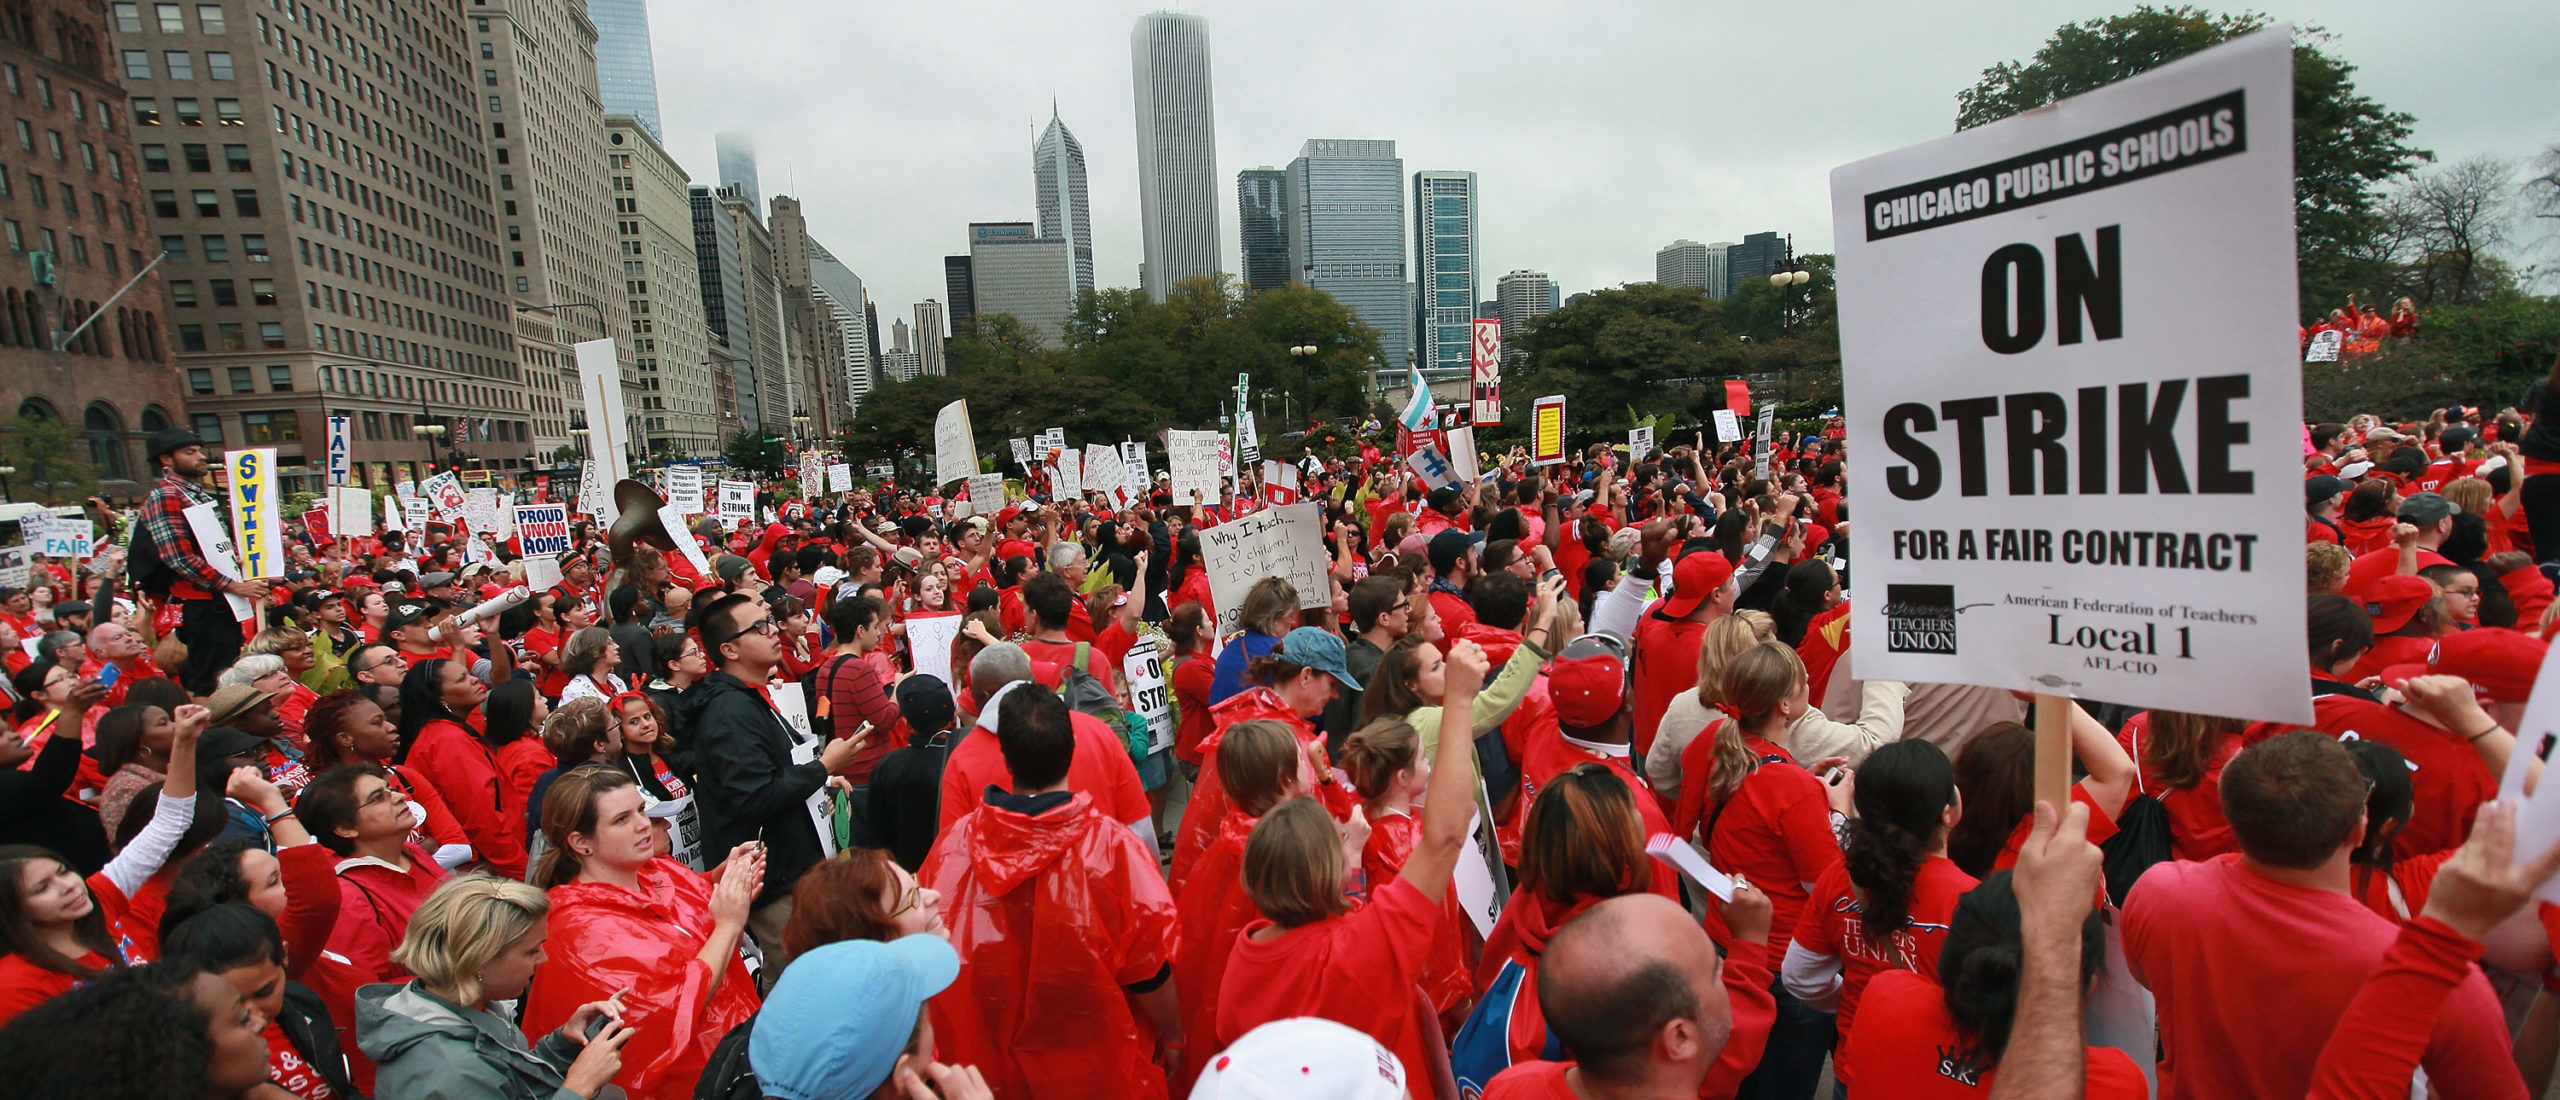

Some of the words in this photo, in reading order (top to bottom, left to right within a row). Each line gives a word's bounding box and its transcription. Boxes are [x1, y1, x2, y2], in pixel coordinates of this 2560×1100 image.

[1874, 178, 1991, 231] CHICAGO
[1996, 150, 2095, 203] PUBLIC
[2102, 109, 2235, 177] SCHOOLS
[1981, 224, 2123, 355] ON
[1170, 432, 1190, 447] Rahm
[1883, 373, 2255, 501] STRIKE
[330, 418, 346, 484] TAFT
[1170, 450, 1185, 460] likes
[1187, 449, 1197, 463] 98
[1186, 464, 1207, 475] should
[730, 491, 742, 501] ON
[1173, 480, 1190, 488] come
[1202, 480, 1213, 490] my
[240, 454, 260, 578] SWIFT
[517, 509, 564, 525] PROUD
[722, 503, 751, 513] STRIKE
[520, 522, 566, 539] UNION
[1211, 532, 1239, 550] Why
[1240, 521, 1254, 538] I
[46, 538, 89, 554] FAIR
[1212, 557, 1225, 570] I
[1247, 529, 1290, 560] children!
[1893, 529, 1949, 560] FOR
[1957, 529, 1979, 560] A
[1986, 529, 2054, 562] FAIR
[2062, 530, 2259, 572] CONTRACT
[1230, 571, 1241, 583] I
[1261, 546, 1299, 573] learning!
[2004, 592, 2069, 609] American
[2074, 597, 2155, 617] Federation
[2159, 605, 2175, 618] of
[2182, 606, 2259, 626] Teachers
[1889, 618, 1956, 632] TEACHERS
[2048, 613, 2159, 656] Local
[2176, 625, 2198, 660] 1
[1889, 631, 1957, 650] UNION
[2083, 656, 2158, 676] AFL-CIO
[1940, 1060, 1976, 1086] S.K.
